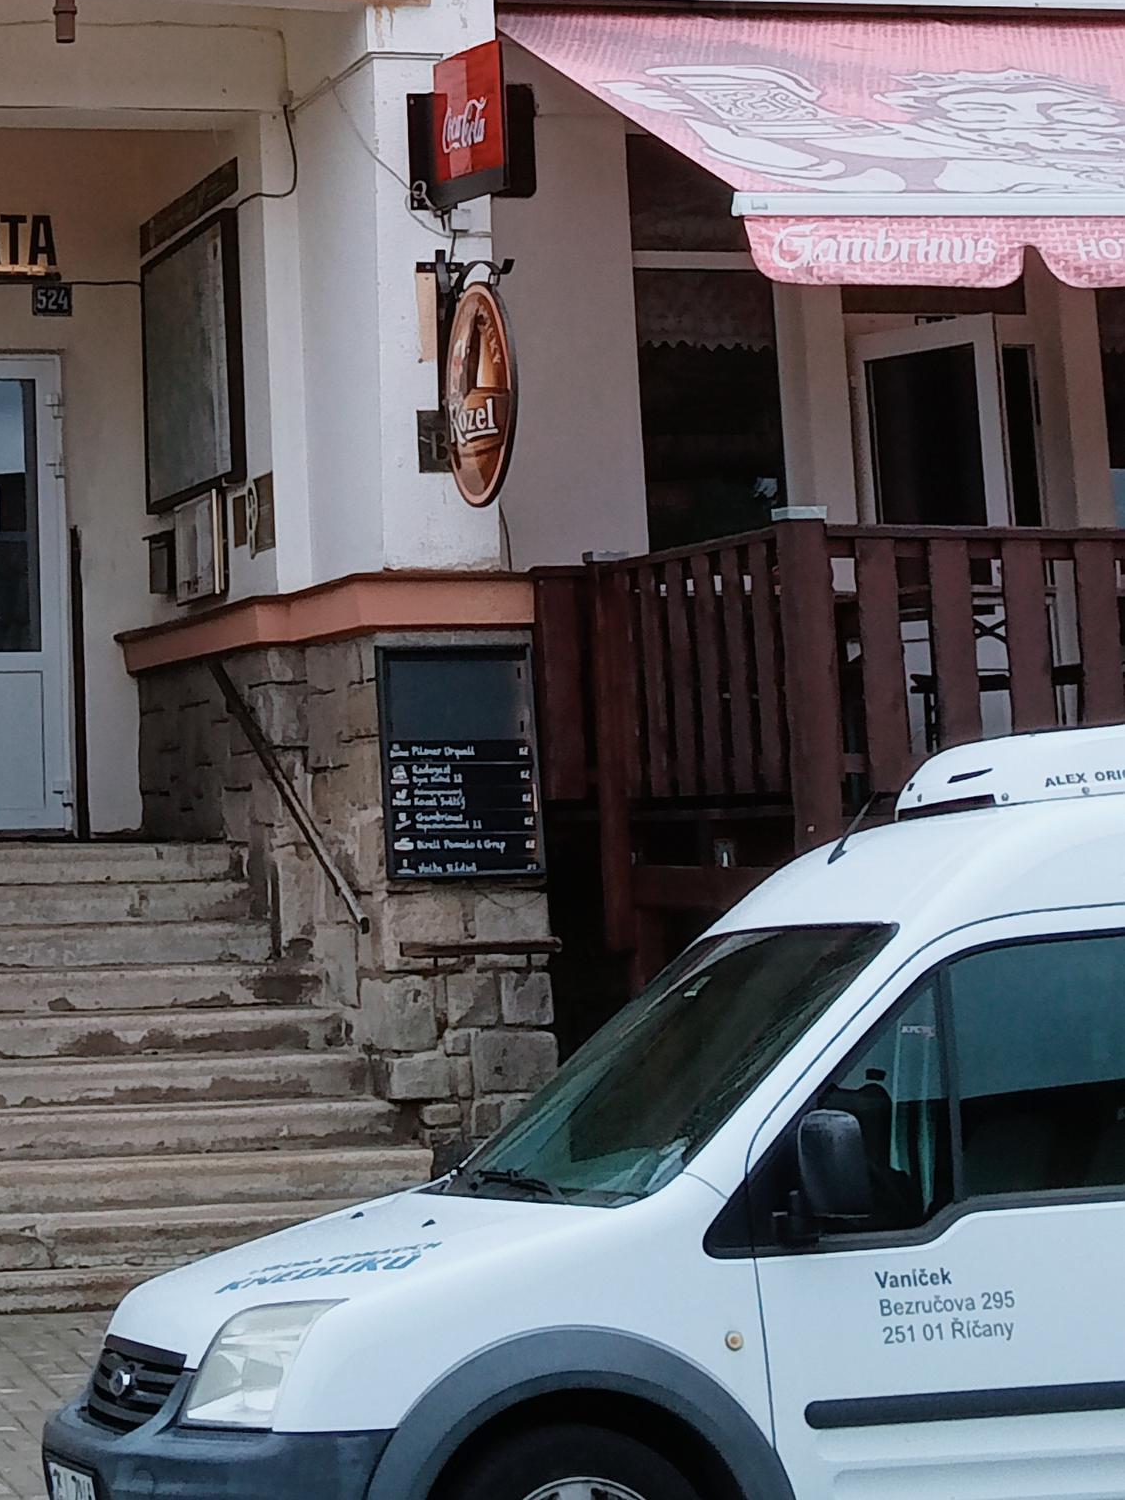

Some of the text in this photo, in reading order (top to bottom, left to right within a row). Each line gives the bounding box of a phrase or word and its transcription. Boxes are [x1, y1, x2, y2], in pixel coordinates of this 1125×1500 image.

[773, 223, 997, 269] Gambrinus
[36, 289, 69, 311] 524
[448, 397, 496, 446] Kozel
[1044, 769, 1125, 788] ALEX ORI
[874, 1267, 952, 1289] Vaníček
[879, 1290, 1015, 1317] Bezručova 295
[882, 1317, 1014, 1344] 251 01 Říčany
